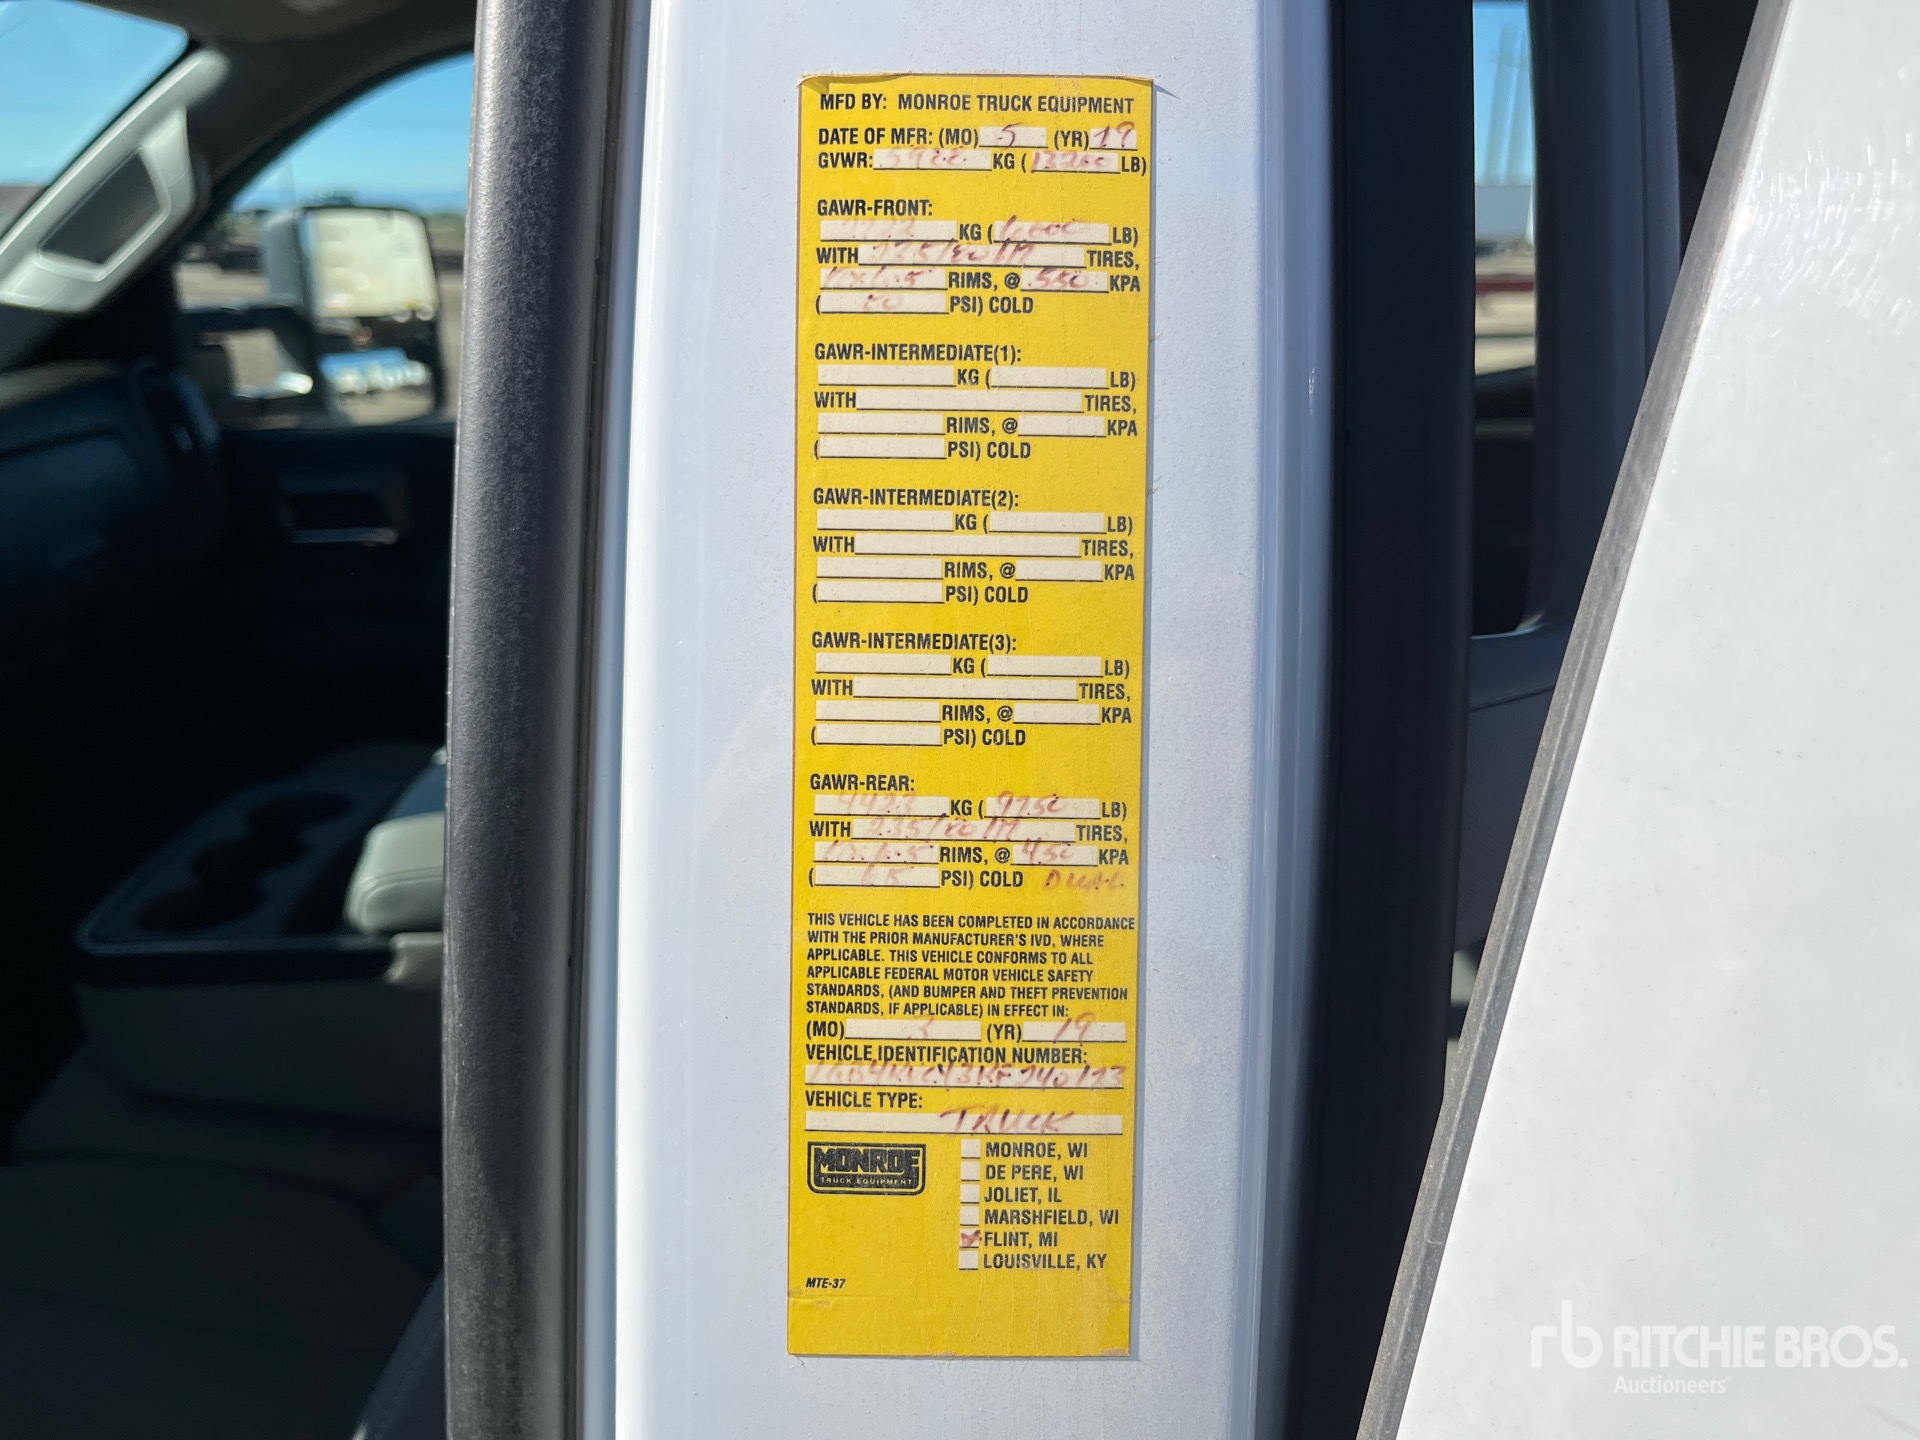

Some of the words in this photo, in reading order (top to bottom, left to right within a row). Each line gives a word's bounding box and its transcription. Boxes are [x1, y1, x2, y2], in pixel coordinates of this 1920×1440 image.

[820, 94, 855, 110] MFD
[861, 94, 887, 110] BY:
[898, 94, 970, 111] MONROE
[977, 95, 1032, 111] TRUCK
[1038, 96, 1134, 113] EQUIPMENT
[819, 128, 859, 145] DATE
[865, 128, 885, 145] OF
[891, 128, 932, 145] MFR:
[939, 128, 978, 148] (MO)
[996, 124, 1023, 148] 5
[1054, 129, 1089, 150] (YR)
[1094, 121, 1135, 148] 19
[819, 153, 873, 169] GVWR:
[993, 153, 1015, 169] KG
[1121, 154, 1146, 175] LB)
[818, 200, 932, 216] GAWR-FRONT:
[960, 224, 981, 240] KG
[1113, 227, 1138, 247] LB)
[817, 248, 858, 264] WITH
[1087, 251, 1140, 270] TIRES,
[949, 273, 998, 291] RIMS,
[1004, 273, 1020, 289] @
[1110, 276, 1140, 292] KPA
[950, 297, 983, 315] PSI)
[989, 297, 1033, 313] COLD
[815, 344, 1021, 363] GAWR-INTERMEDIATE(1):
[958, 370, 979, 386] KG
[1110, 372, 1135, 391] LB)
[815, 392, 856, 408] WITH
[1085, 395, 1136, 415] TIRES,
[947, 418, 995, 436] RIMS,
[1002, 418, 1018, 434] @
[1107, 421, 1137, 436] KPA
[948, 442, 981, 461] PSI)
[987, 442, 1031, 458] COLD
[814, 489, 1019, 508] GAWR-INTERMEDIATE(2):
[955, 514, 977, 530] KG
[1107, 516, 1132, 535] LB)
[813, 536, 854, 552] WITH
[1082, 540, 1134, 559] TIRES,
[944, 562, 993, 581] RIMS,
[1000, 563, 1015, 578] @
[1104, 565, 1134, 580] KPA
[946, 587, 978, 606] PSI)
[985, 587, 1028, 603] COLD
[812, 632, 1016, 653] GAWR-INTERMEDIATE(3):
[953, 658, 974, 674] KG
[1104, 660, 1130, 679] LB)
[812, 680, 853, 696] WITH
[1079, 684, 1131, 703] TIRES,
[942, 706, 990, 725] RIMS,
[998, 706, 1013, 722] @
[1102, 708, 1132, 724] KPA
[944, 730, 976, 749] PSI)
[982, 730, 1026, 746] COLD
[811, 775, 914, 791] GAWR-REAR:
[951, 800, 972, 816] KG
[1102, 802, 1127, 822] LB)
[810, 822, 851, 838] WITH
[1076, 826, 1127, 844] TIRES,
[940, 847, 988, 866] RIMS,
[995, 848, 1010, 863] @
[1099, 850, 1129, 865] KPA
[941, 871, 974, 890] PSI)
[980, 872, 1023, 887] COLD
[808, 913, 835, 926] THIS
[841, 914, 889, 927] VEHICLE
[894, 915, 918, 927] HAS
[923, 915, 954, 928] BEEN
[959, 916, 1032, 929] COMPLETED
[1037, 917, 1049, 929] IN
[1053, 917, 1135, 930] ACCORDANCE
[807, 931, 838, 943] WITH
[844, 931, 866, 944] THE
[870, 932, 907, 944] PRIOR
[1031, 934, 1055, 948] IVD,
[1061, 934, 1104, 947] WHERE
[807, 949, 885, 962] APPLICABLE.
[890, 950, 917, 962] THIS
[922, 950, 972, 963] VEHICLE
[977, 951, 1047, 964] CONFORMS
[1052, 952, 1066, 964] TO
[1071, 952, 1093, 965] ALL
[807, 967, 880, 980] APPLICABLE
[885, 968, 939, 980] FEDERAL
[944, 968, 988, 981] MOTOR
[993, 969, 1044, 982] VEHICLE
[1048, 969, 1094, 982] SAFETY
[807, 984, 884, 999] STANDARDS,
[889, 985, 919, 999] (AND
[924, 986, 976, 998] BUMPER
[981, 986, 1006, 999] AND
[1011, 987, 1047, 999] THEFT
[1052, 987, 1127, 1000] PREVENTION
[807, 1002, 884, 1016] STANDARDS,
[889, 1002, 899, 1015] IF
[904, 1003, 982, 1017] APPLICABLE)
[988, 1004, 999, 1016] IN
[1004, 1004, 1047, 1016] EFFECT
[1053, 1005, 1068, 1017] IN:
[807, 1020, 845, 1041] (MO)
[987, 1022, 1022, 1043] (YR)
[1053, 1010, 1095, 1045] 19
[806, 1045, 873, 1061] VEHICLE
[878, 1047, 1006, 1063] IDENTIFICATION
[1012, 1048, 1087, 1064] NUMBER:
[806, 1092, 871, 1107] VEHICLE
[878, 1093, 923, 1108] TYPE:
[940, 1104, 1074, 1133] TRUCK
[815, 1146, 920, 1175] MONROE
[986, 1142, 1061, 1160] MONROE,
[1068, 1144, 1087, 1159] WI
[857, 1178, 912, 1186] EQUIPMENT
[986, 1165, 1006, 1179] DE
[1012, 1165, 1058, 1182] PERE,
[1064, 1166, 1083, 1181] WI
[984, 1187, 1041, 1204] JOLIET,
[1048, 1188, 1061, 1203] IL
[985, 1209, 1093, 1227] MARSHFIELD,
[1099, 1210, 1119, 1224] WI
[985, 1232, 1032, 1249] FLINT,
[1039, 1232, 1058, 1247] MI
[984, 1254, 1080, 1270] LOUISVILLE,
[1087, 1254, 1106, 1269] KY
[806, 1278, 845, 1289] MTE-37
